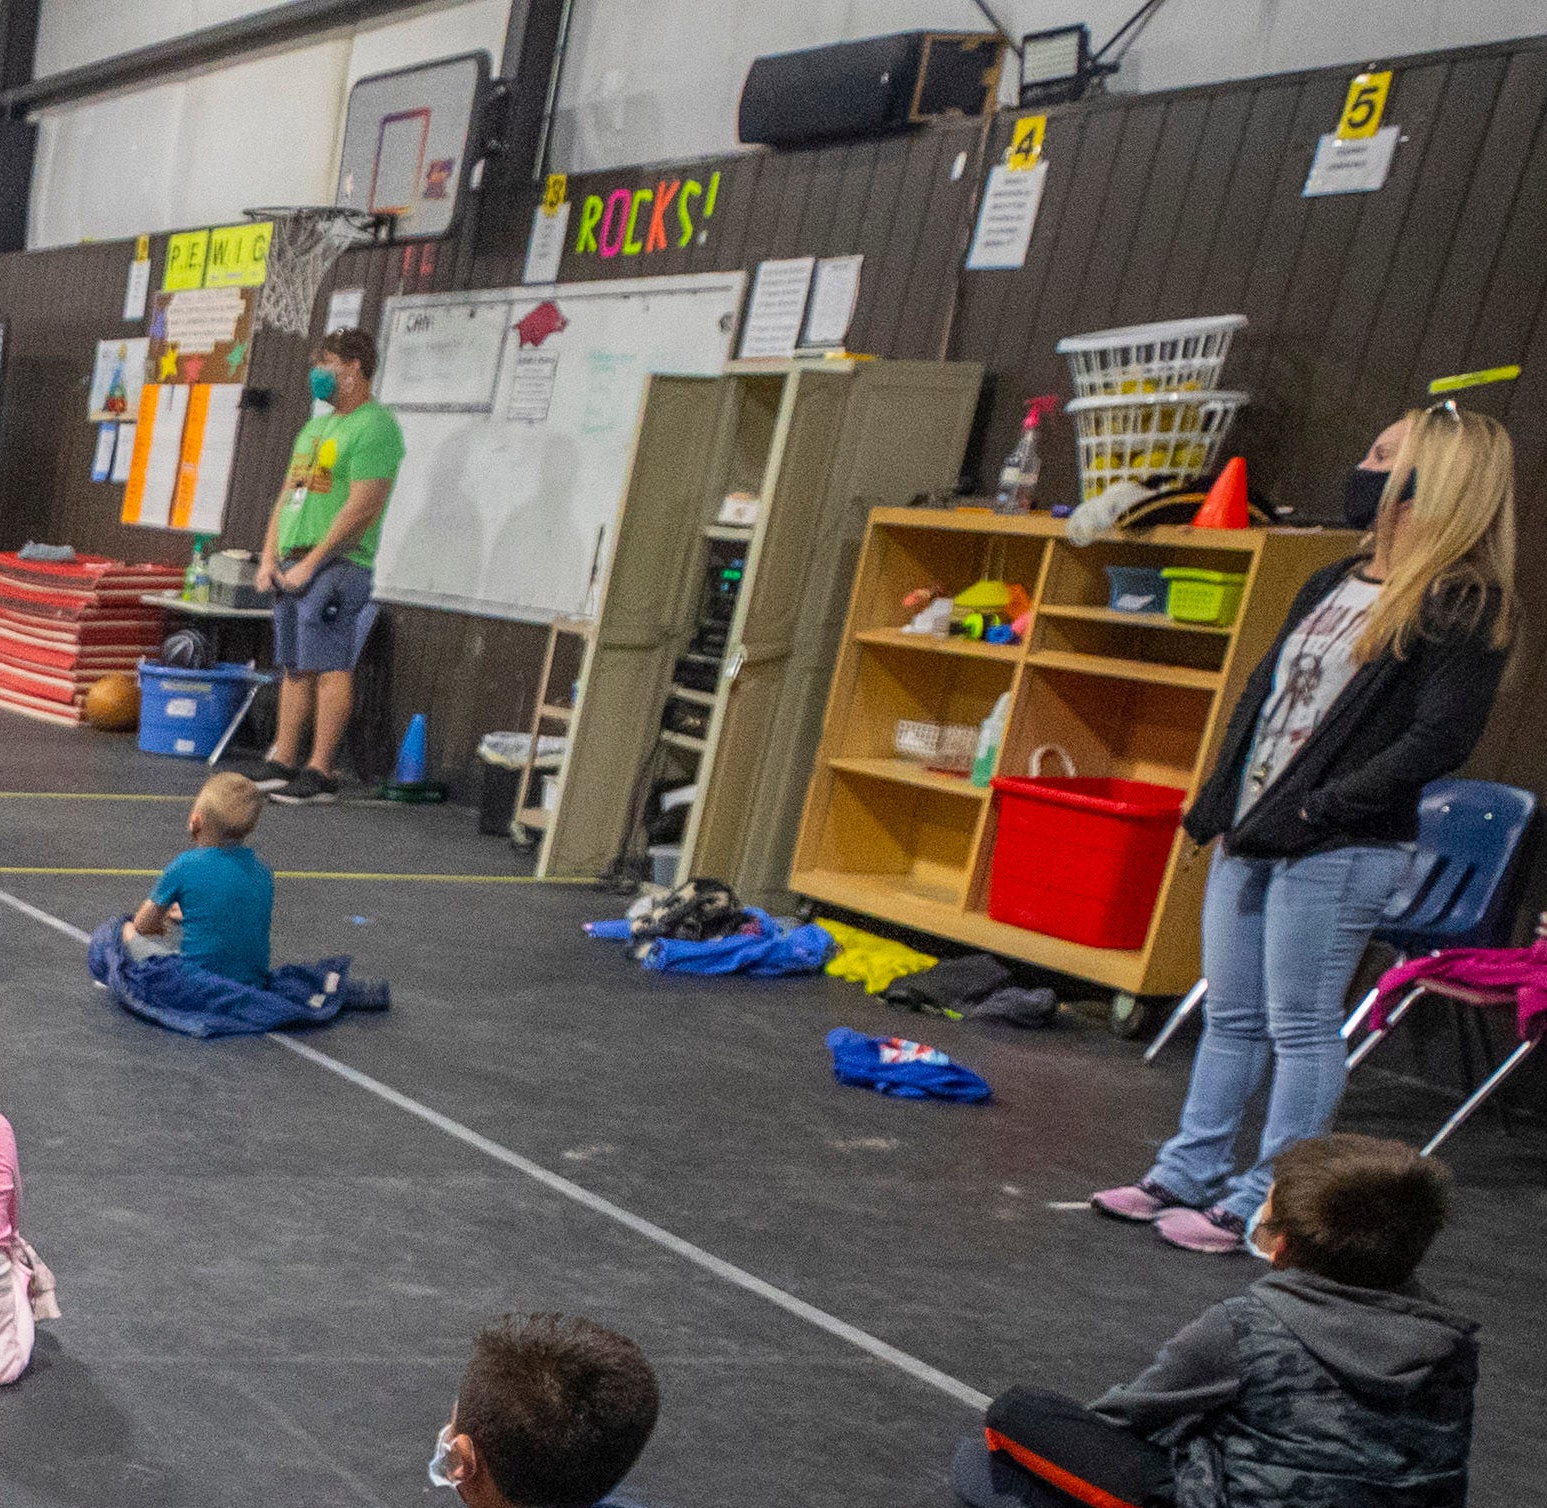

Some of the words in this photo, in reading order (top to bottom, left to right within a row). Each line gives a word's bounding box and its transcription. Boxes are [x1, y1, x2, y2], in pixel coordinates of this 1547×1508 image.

[1347, 86, 1379, 129] 5
[1015, 126, 1037, 161] 4
[576, 171, 721, 258] ROCKS!
